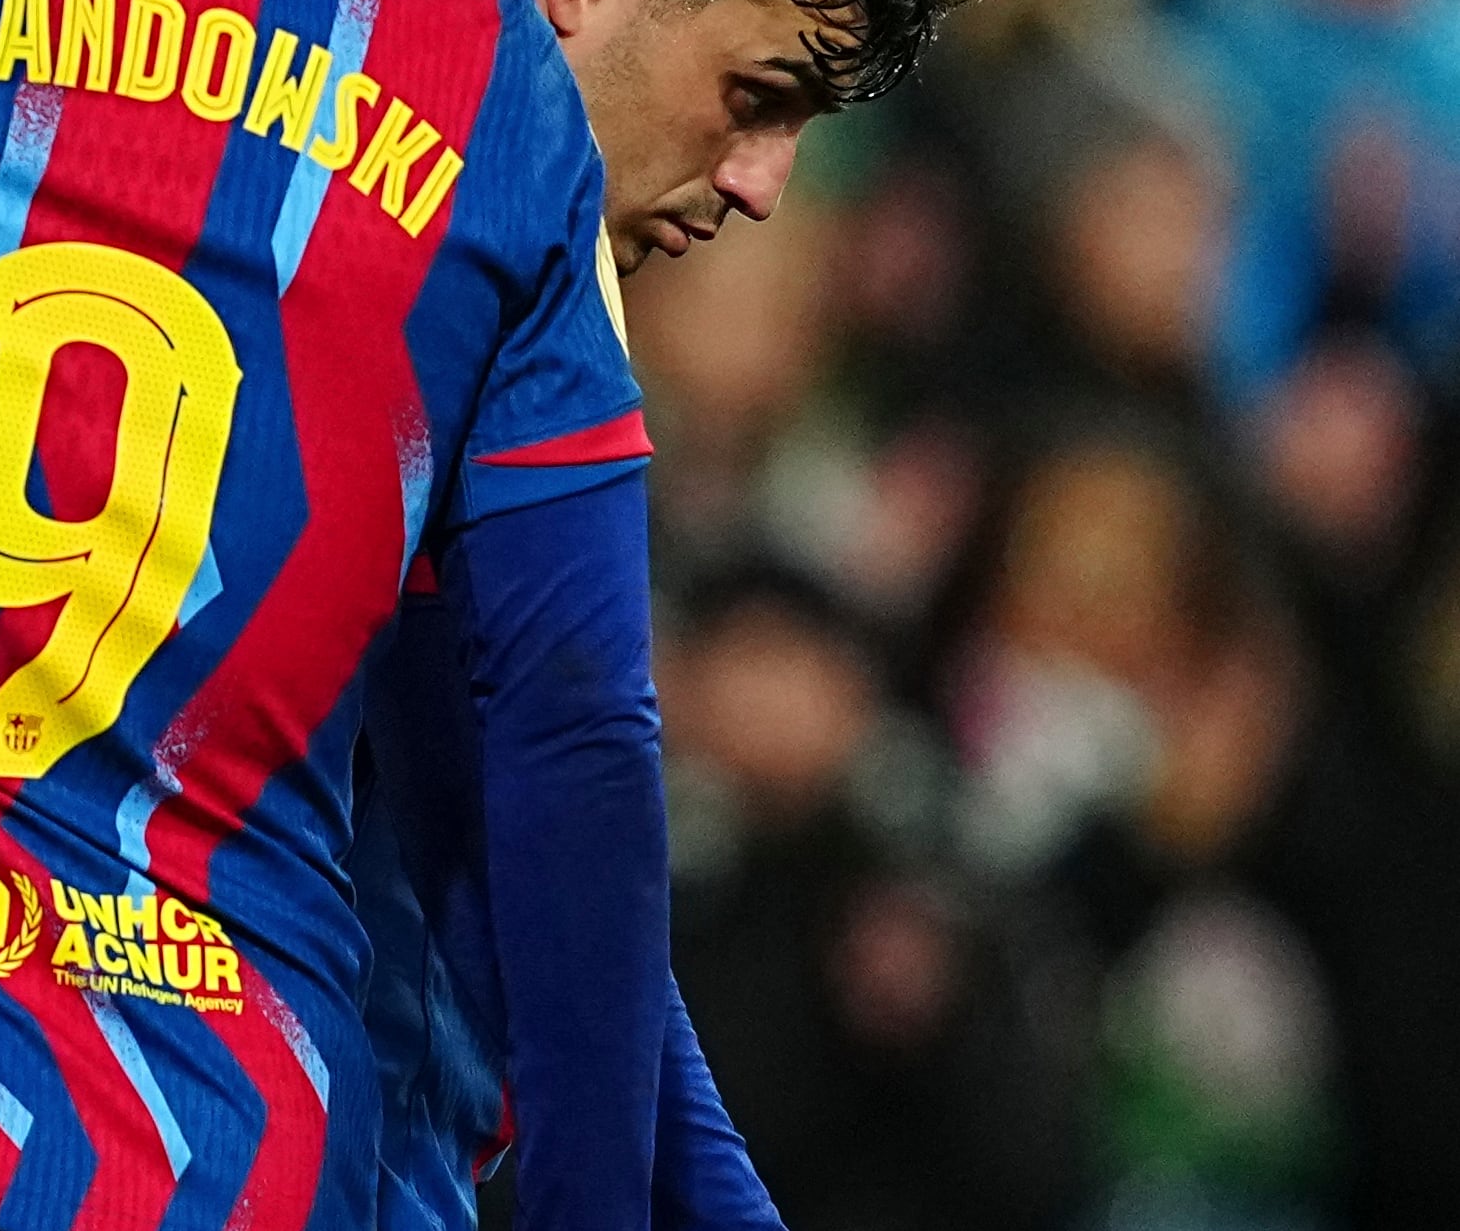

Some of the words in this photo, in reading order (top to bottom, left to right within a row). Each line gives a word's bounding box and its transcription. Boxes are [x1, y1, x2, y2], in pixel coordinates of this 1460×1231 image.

[50, 878, 233, 947] UNHCR
[50, 923, 242, 993] ACNUR
[53, 968, 88, 989] The
[90, 973, 119, 995] UN
[121, 978, 182, 1006] Refugee
[185, 992, 244, 1016] Agency
